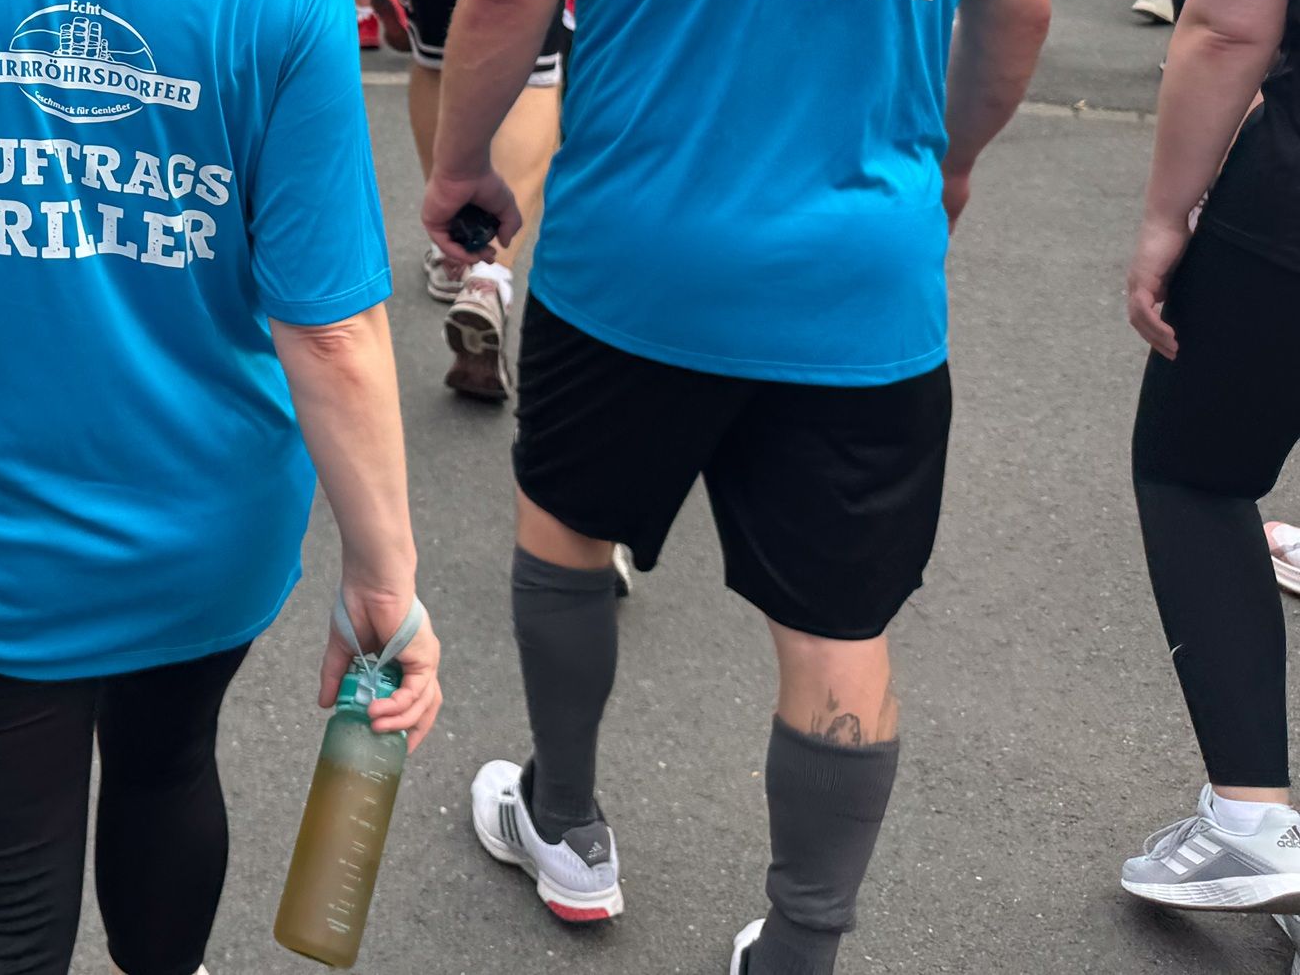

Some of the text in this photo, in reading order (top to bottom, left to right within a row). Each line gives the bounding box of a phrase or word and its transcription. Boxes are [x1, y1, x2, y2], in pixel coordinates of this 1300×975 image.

[69, 0, 101, 16] Echt
[34, 90, 131, 115] Geschmack für Genießer
